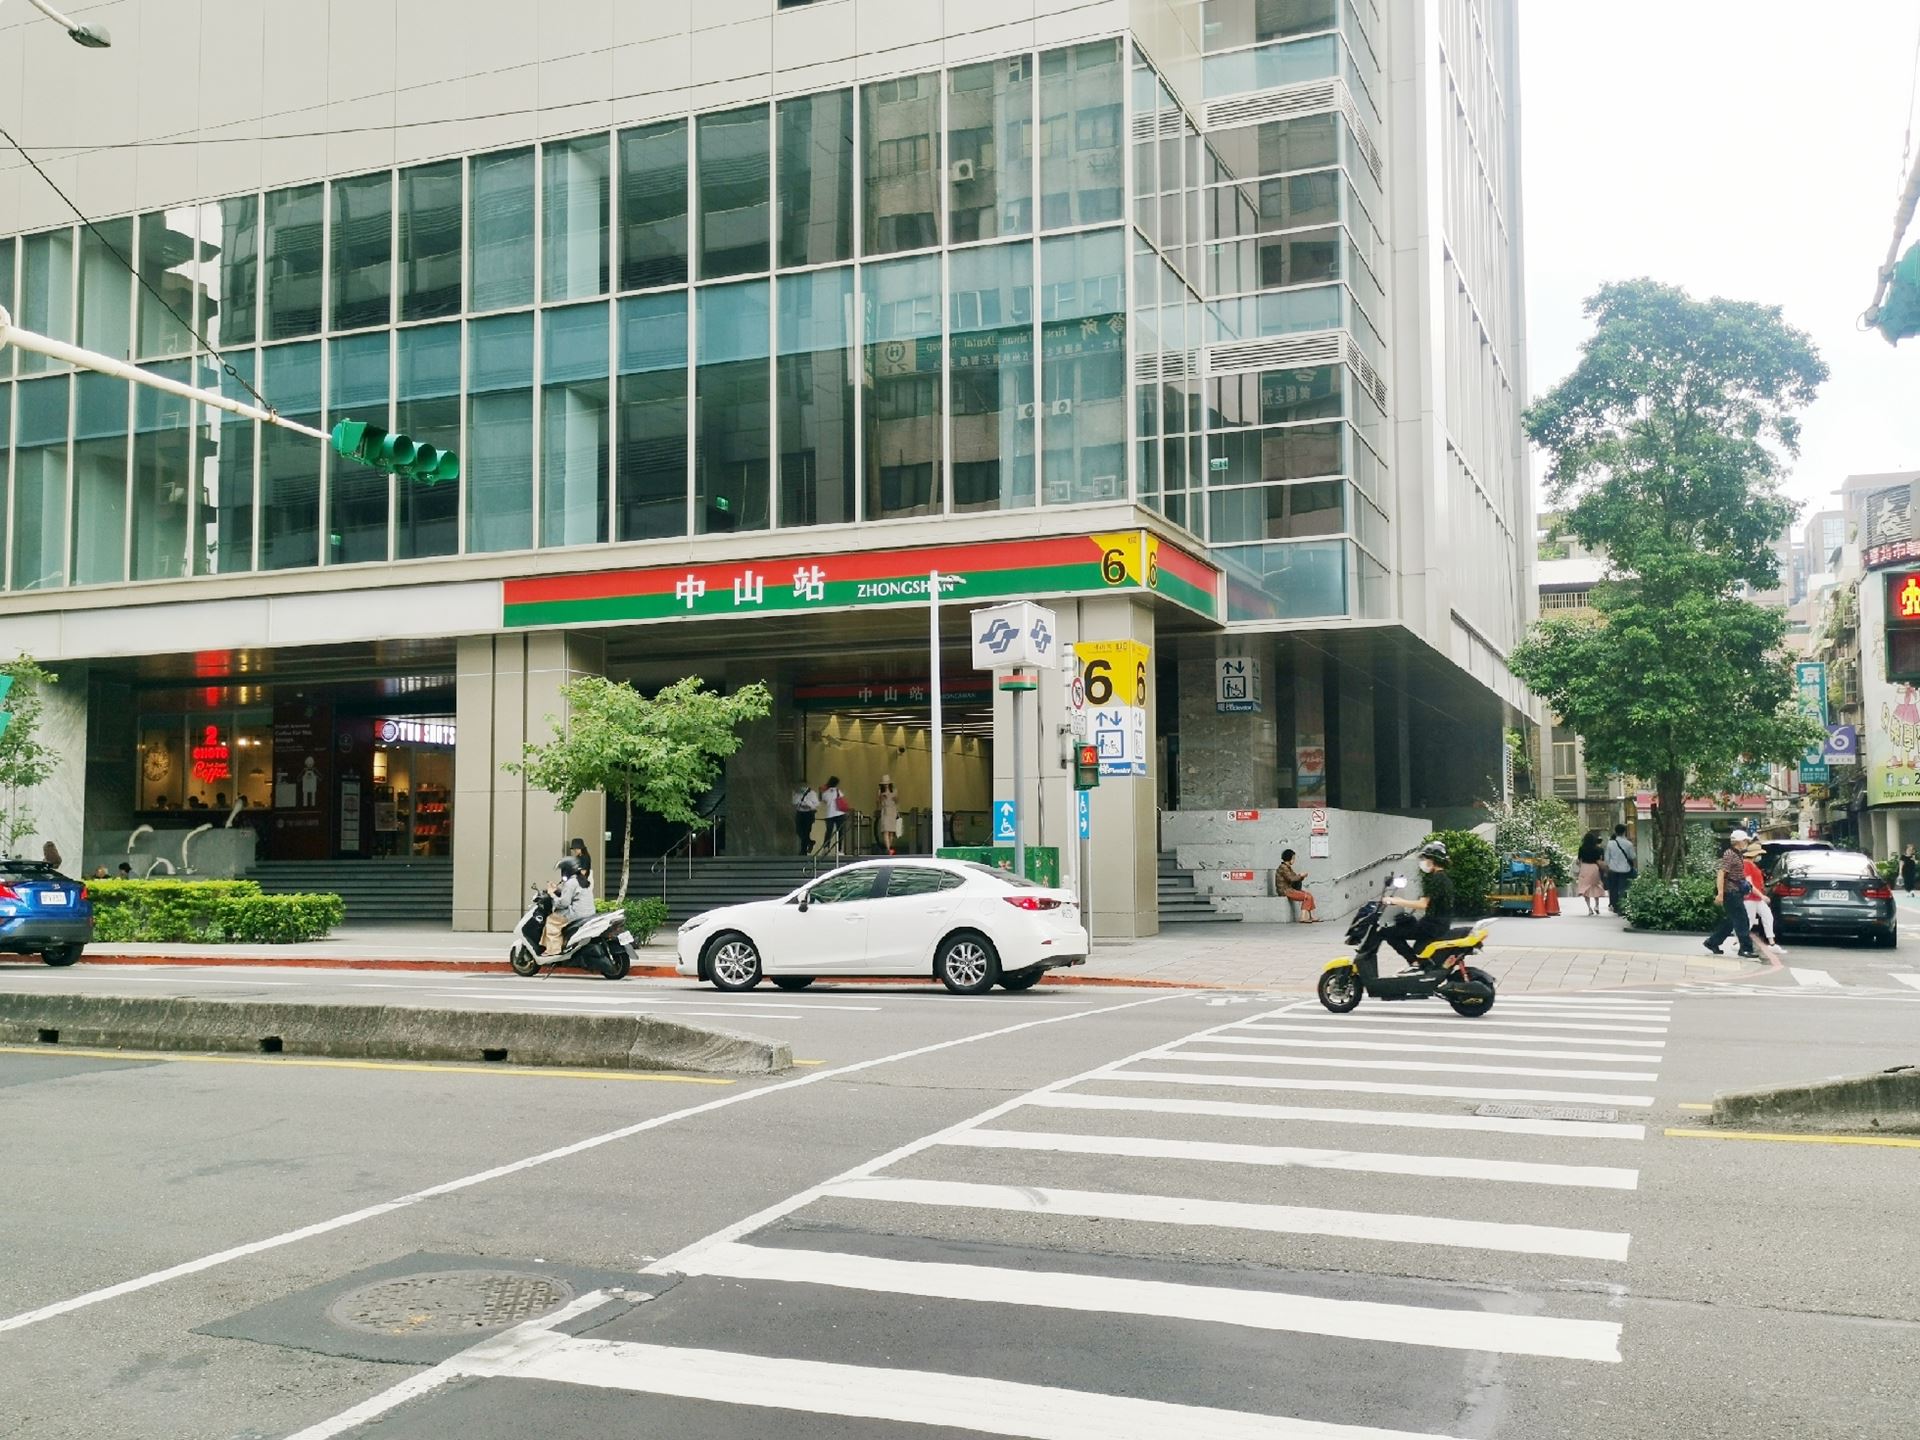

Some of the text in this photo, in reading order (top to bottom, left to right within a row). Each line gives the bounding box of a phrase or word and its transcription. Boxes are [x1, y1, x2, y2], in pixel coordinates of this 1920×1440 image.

[1103, 548, 1126, 584] 6
[1149, 551, 1157, 587] 6
[675, 565, 826, 609] 中山站
[858, 686, 924, 703] 中山站
[1084, 659, 1113, 705] 6
[1137, 661, 1146, 706] 6
[205, 725, 218, 745] 2
[424, 724, 456, 745] SHOTS
